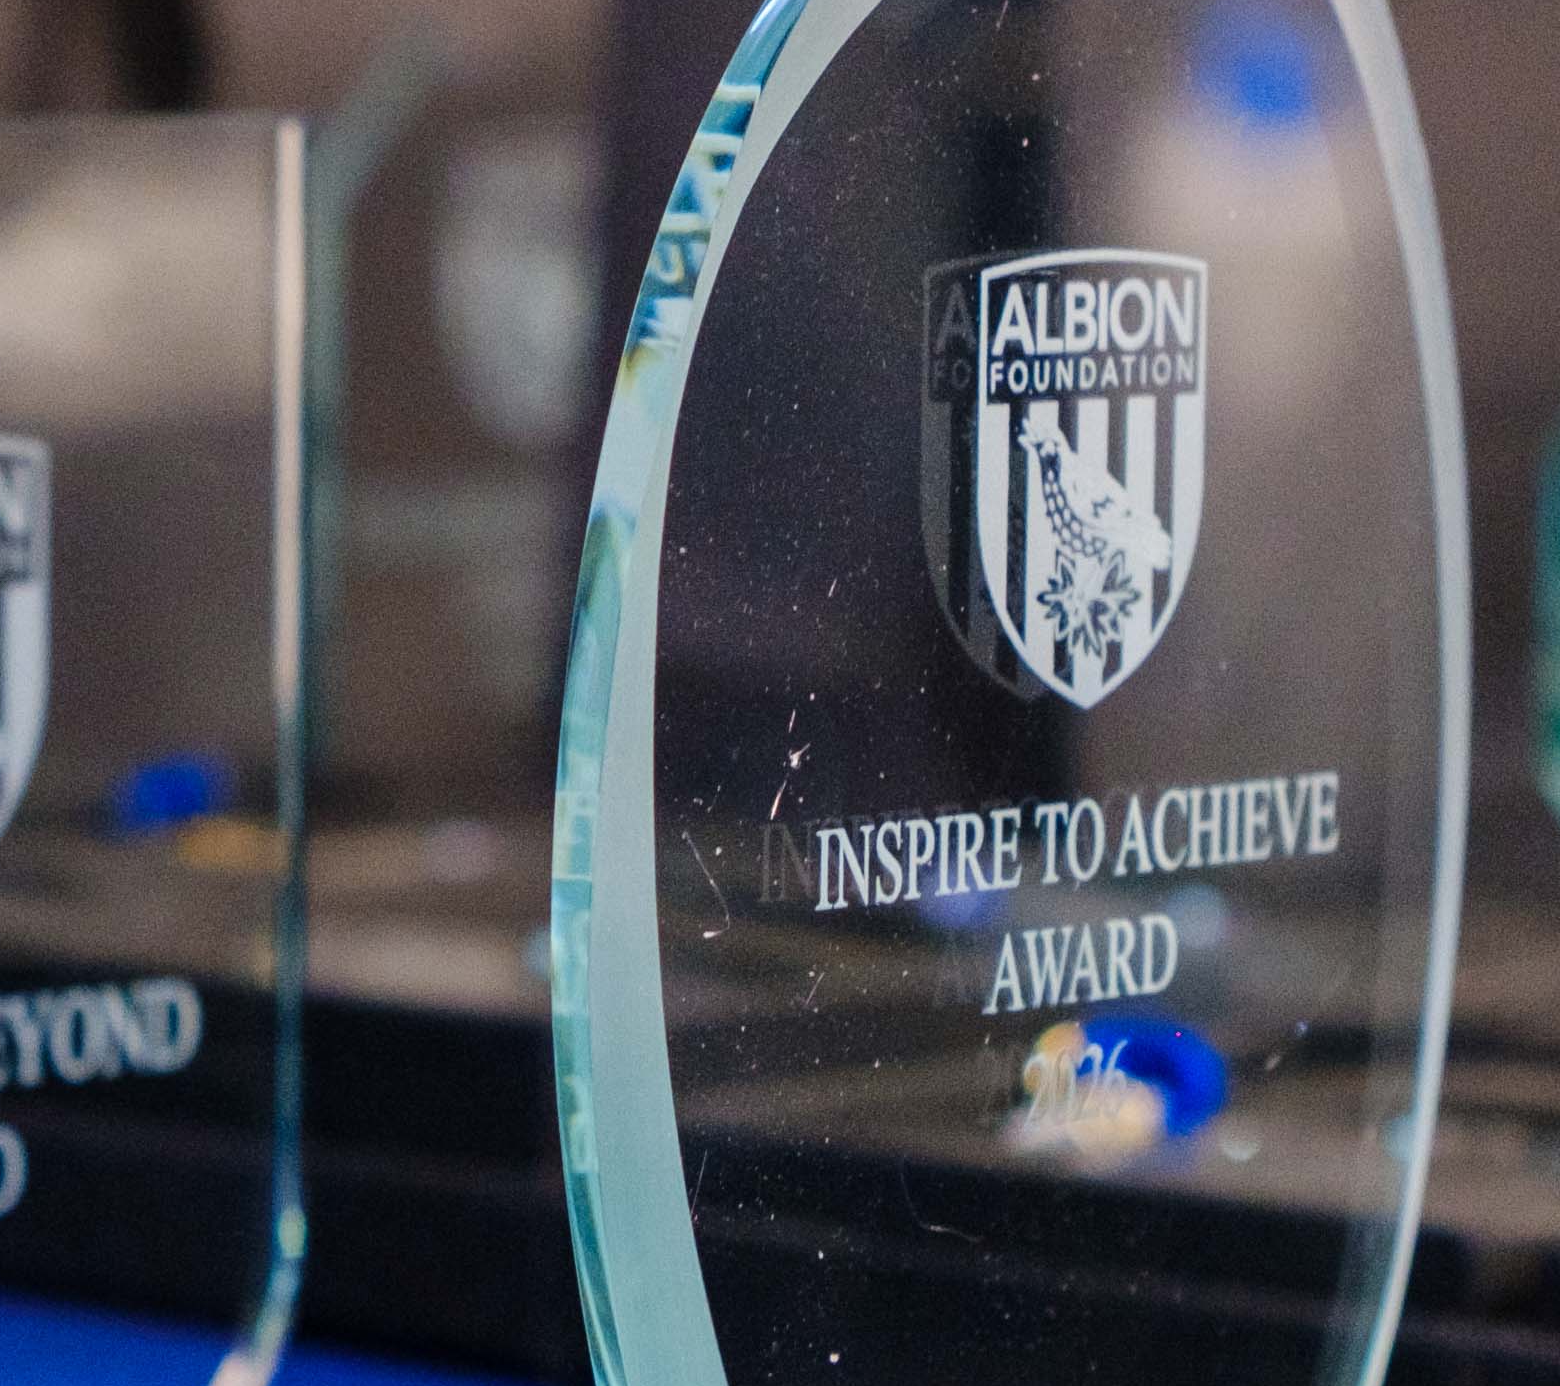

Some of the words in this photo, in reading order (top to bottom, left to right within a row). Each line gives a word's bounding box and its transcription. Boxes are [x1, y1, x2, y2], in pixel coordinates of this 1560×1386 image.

[991, 277, 1195, 356] ALBION
[990, 354, 1194, 396] FOUNDATION
[815, 805, 1021, 912] INSPIRE
[1034, 797, 1106, 884] TO
[1114, 769, 1340, 879] ACHIEVE
[983, 913, 1179, 1015] AWARD
